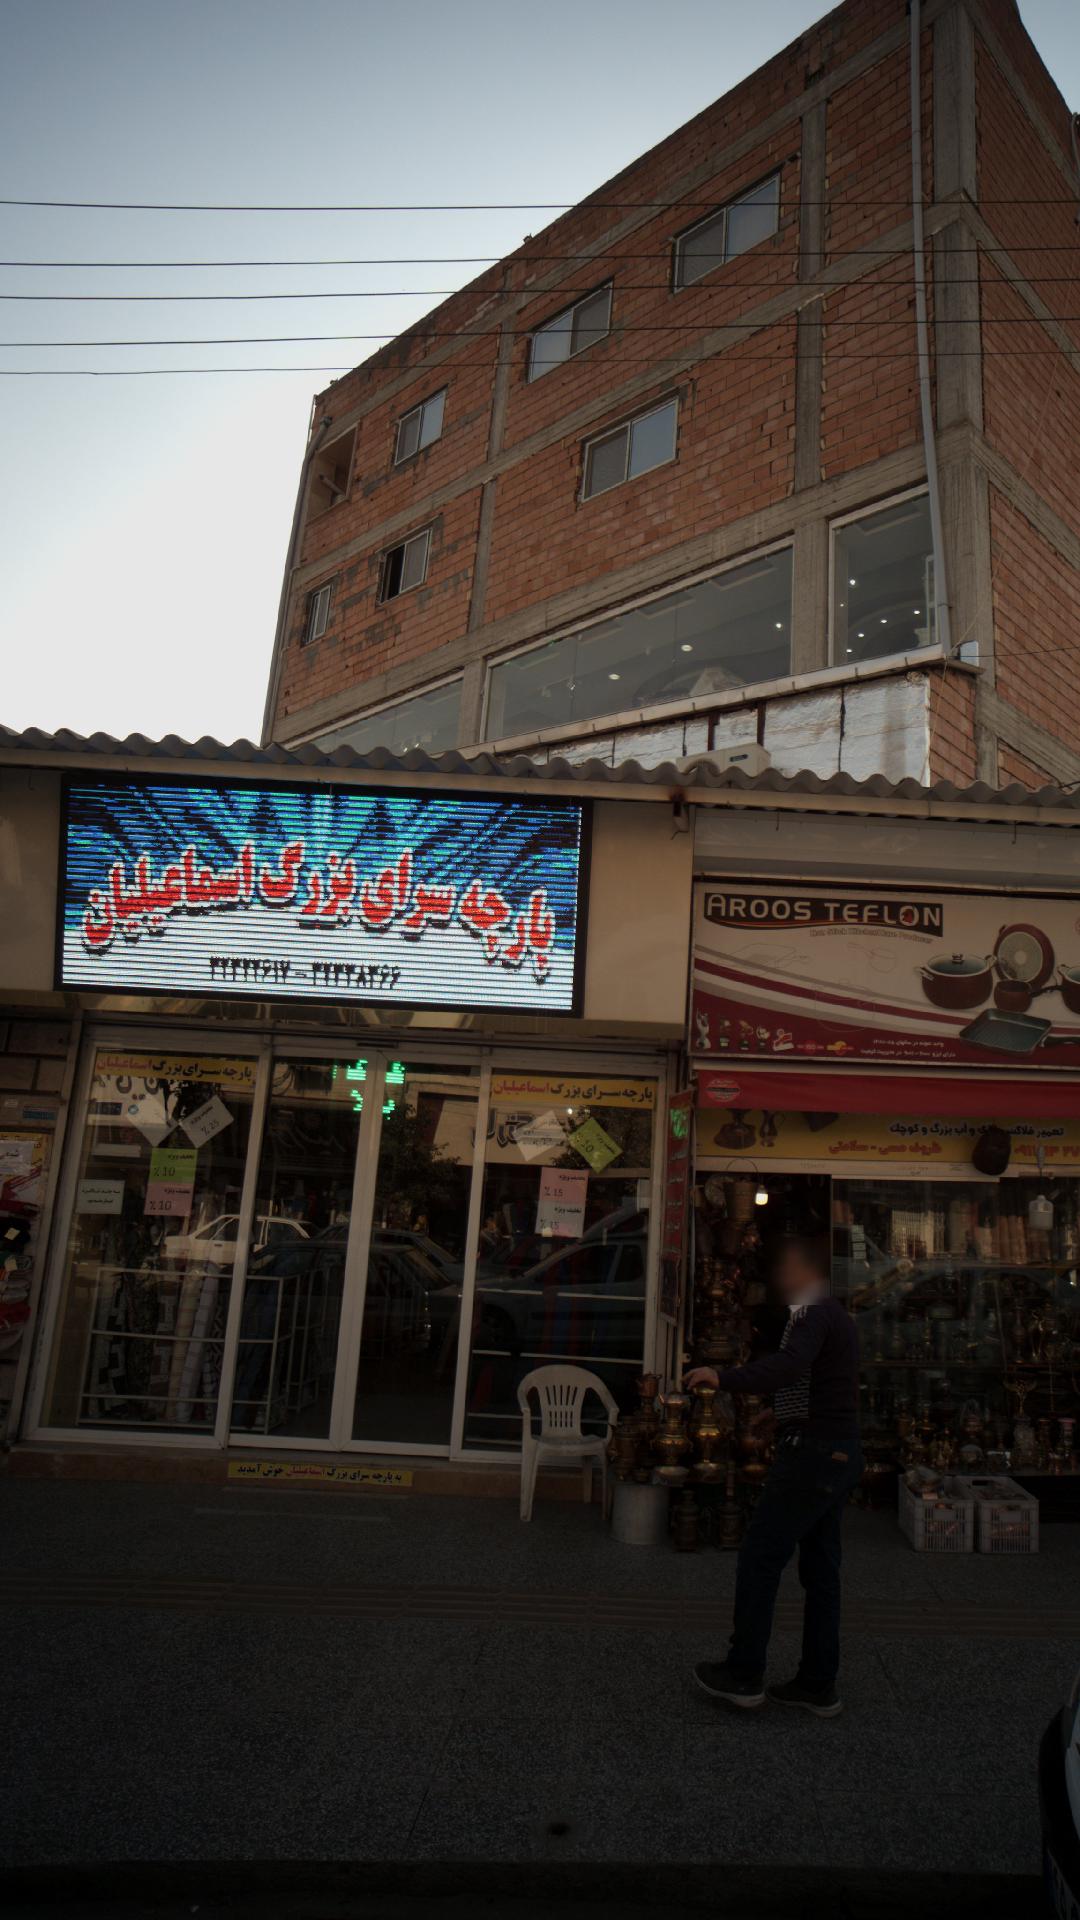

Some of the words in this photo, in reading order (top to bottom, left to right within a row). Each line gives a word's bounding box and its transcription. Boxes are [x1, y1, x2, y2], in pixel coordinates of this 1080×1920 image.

[259, 838, 357, 929] بزرگ
[361, 847, 455, 940] سرای
[706, 893, 812, 922] AROOS
[823, 901, 941, 928] TEFLON
[152, 1059, 182, 1076] بزرگ
[182, 1062, 222, 1078] سرای
[493, 1080, 549, 1095] اسماعیلیان
[550, 1083, 582, 1099] بزرگ
[582, 1084, 621, 1100] سرای
[623, 1086, 653, 1103] پارچه
[889, 1122, 919, 1136] کوچک
[930, 1122, 953, 1136] بزرگ
[1037, 1126, 1065, 1138] تعمیر
[162, 1167, 176, 1177] 10
[158, 1200, 172, 1210] 10
[237, 1463, 262, 1473] آمدید
[262, 1466, 284, 1477] خوش
